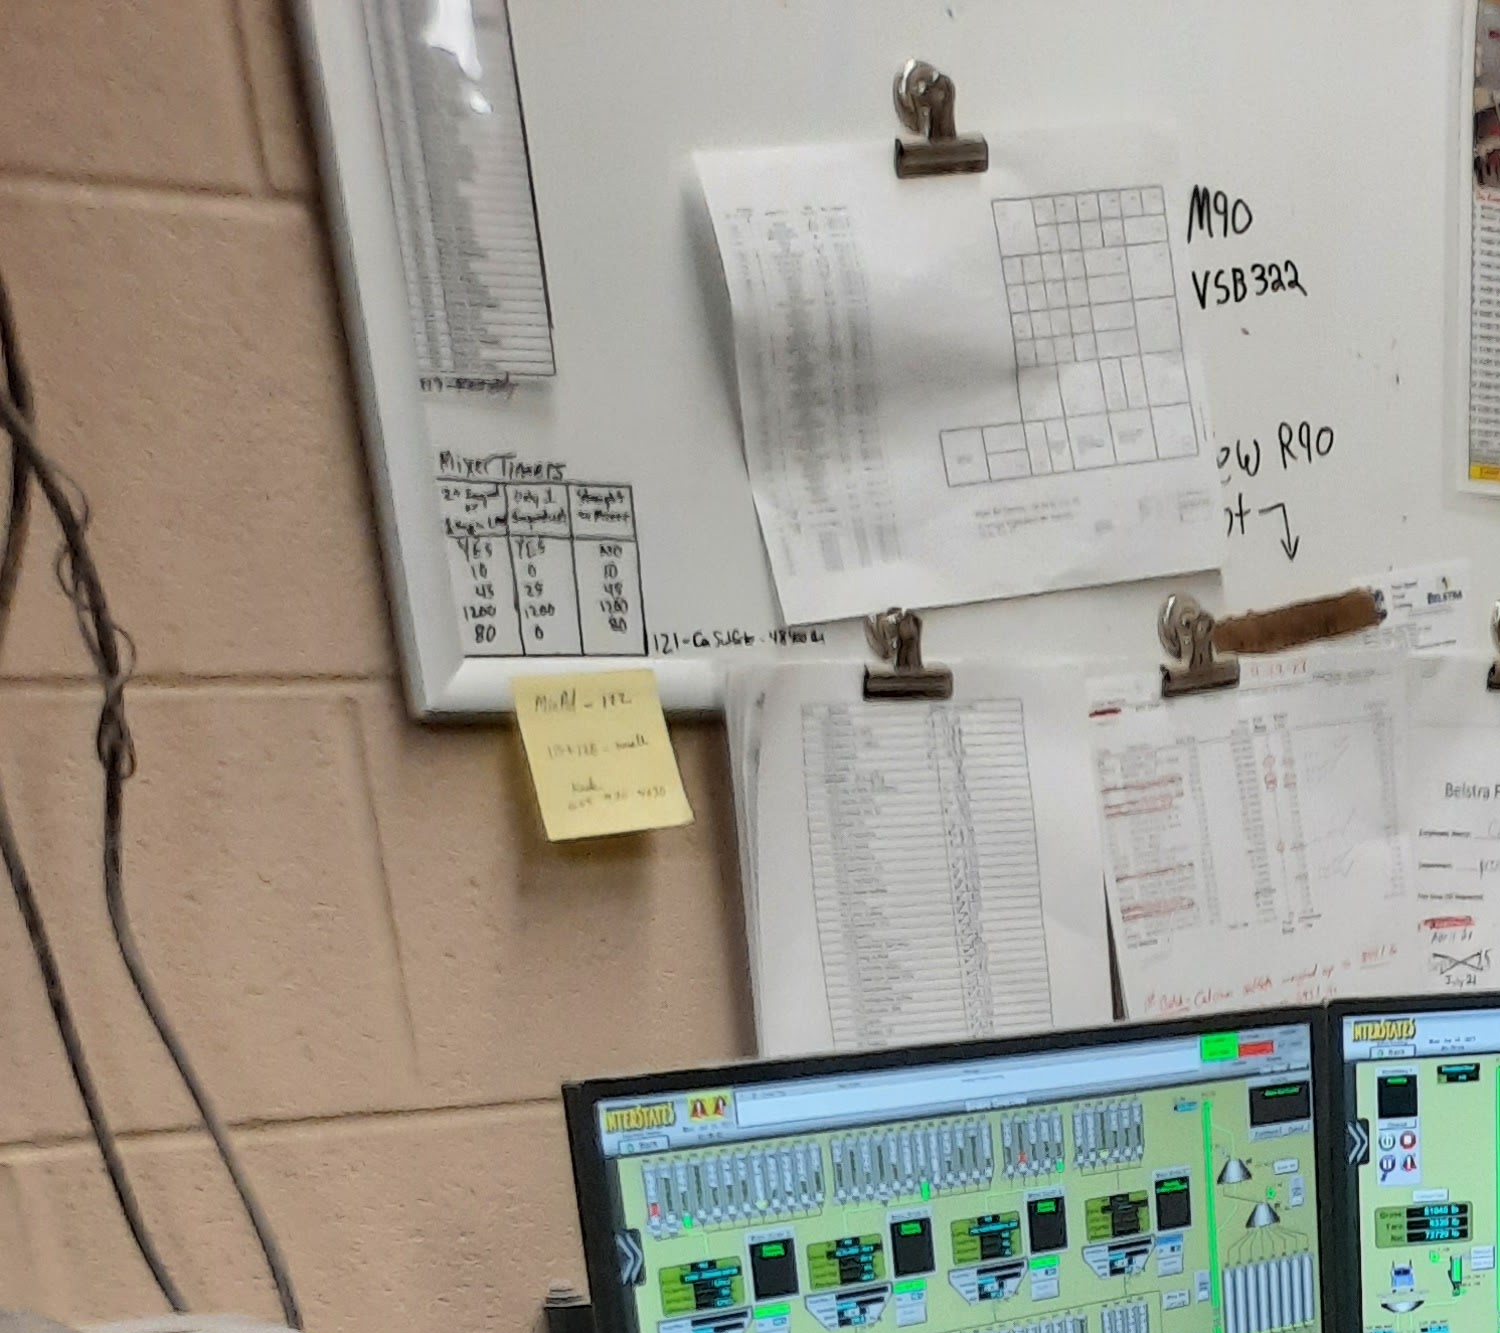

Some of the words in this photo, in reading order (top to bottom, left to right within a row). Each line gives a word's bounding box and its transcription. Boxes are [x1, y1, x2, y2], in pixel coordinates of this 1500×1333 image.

[1187, 184, 1253, 244] M90
[1278, 421, 1334, 470] R90
[1445, 782, 1490, 798] Belstra
